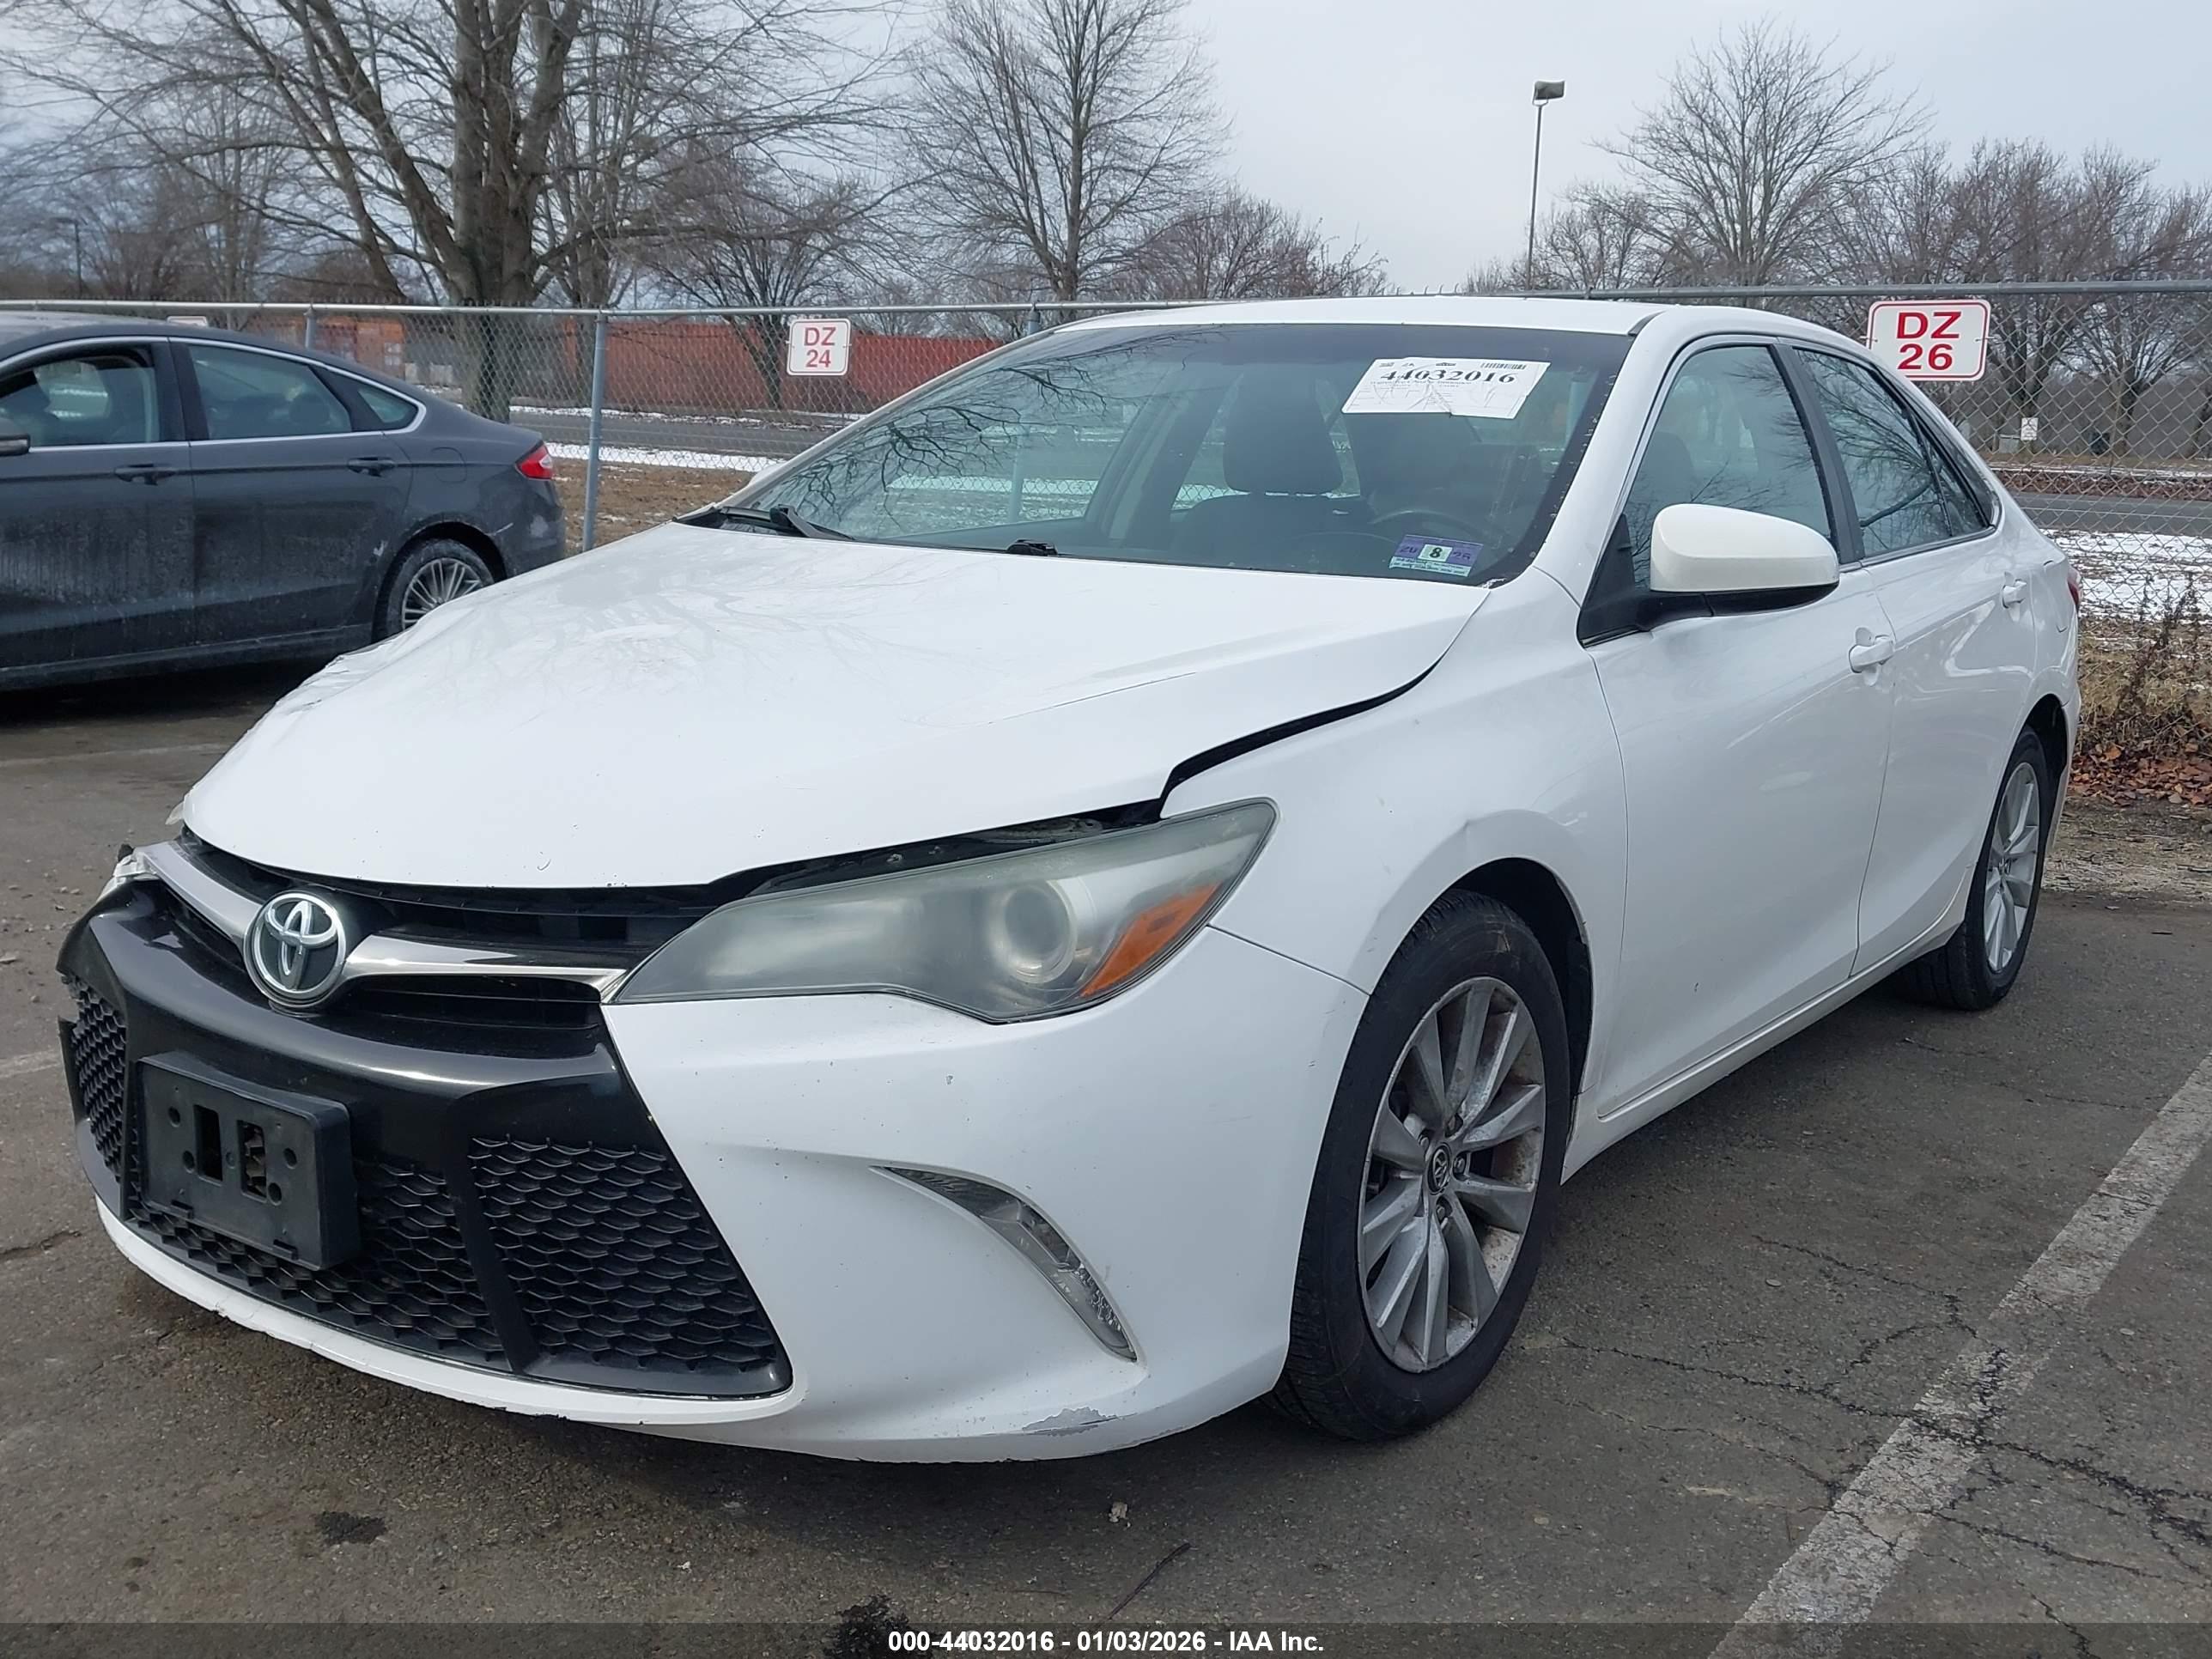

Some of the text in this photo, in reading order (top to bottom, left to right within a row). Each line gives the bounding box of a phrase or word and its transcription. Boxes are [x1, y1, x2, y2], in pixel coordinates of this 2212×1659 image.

[1896, 311, 1961, 339] DZ
[804, 326, 836, 346] DZ
[805, 349, 831, 368] 24
[1897, 343, 1953, 371] 26
[1380, 369, 1516, 383] 44032016
[1429, 546, 1443, 558] 8
